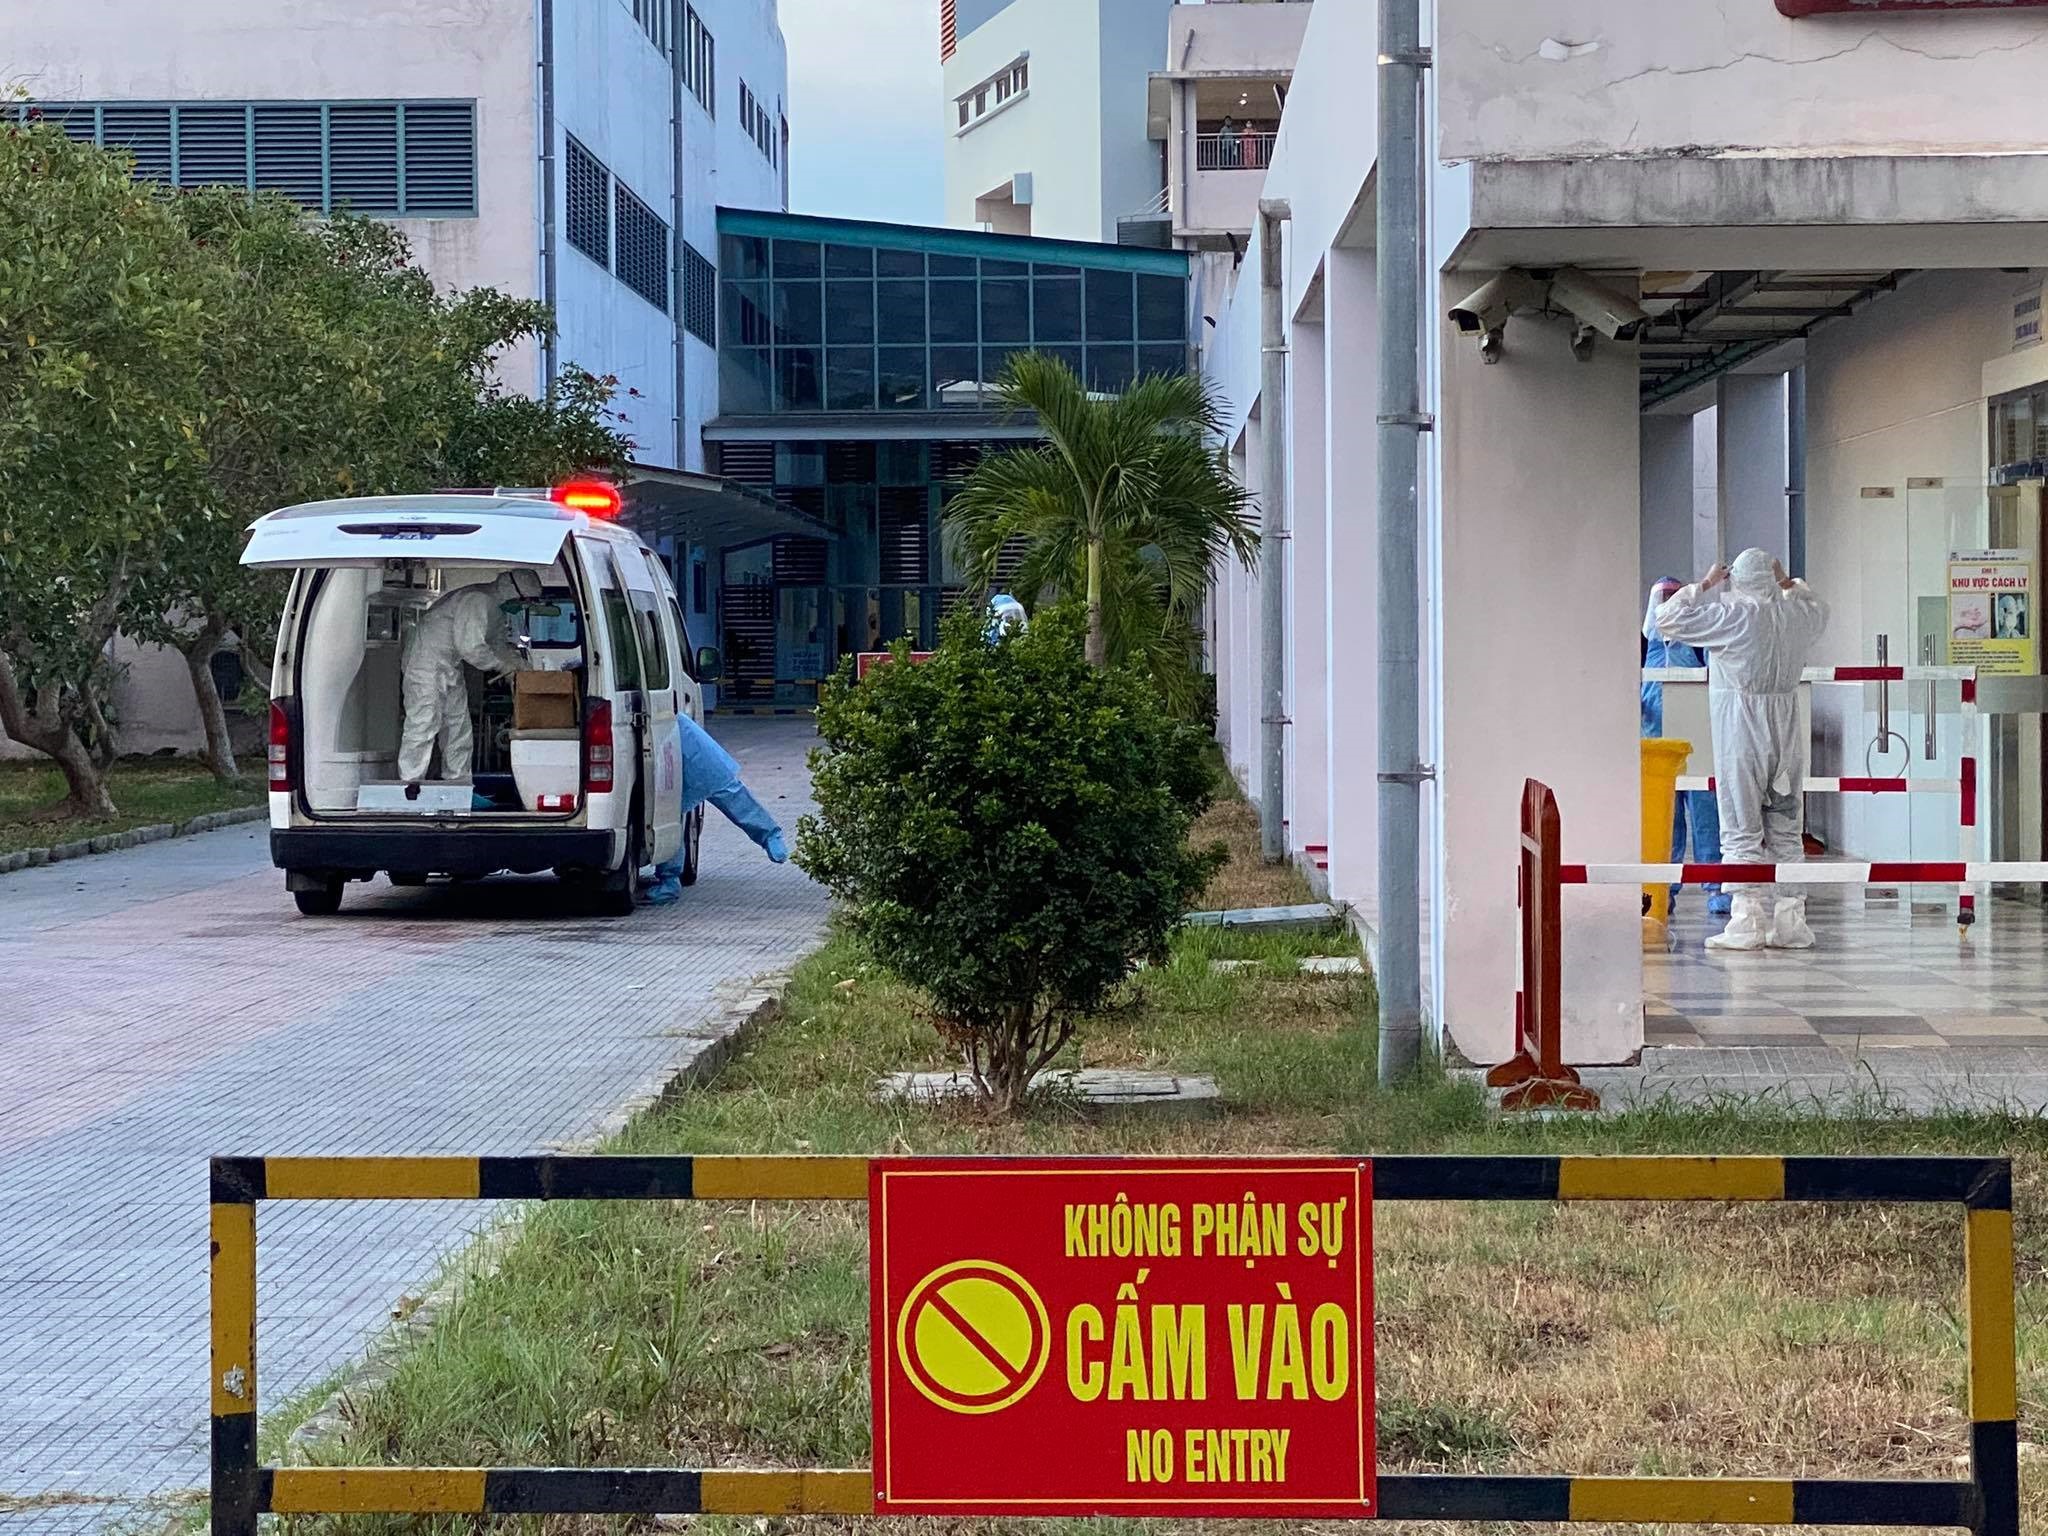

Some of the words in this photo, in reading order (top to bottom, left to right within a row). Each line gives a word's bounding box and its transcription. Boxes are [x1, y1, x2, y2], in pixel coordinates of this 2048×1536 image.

[1952, 578, 1970, 588] KHU
[1972, 577, 1990, 590] VỰC
[1065, 1192, 1182, 1258] KHÔNG
[1193, 1191, 1287, 1269] PHẬN
[1297, 1197, 1347, 1269] SỰ
[1066, 1268, 1207, 1402] CẤM
[1228, 1283, 1350, 1402] VÀO
[1126, 1429, 1174, 1483] NO
[1185, 1429, 1291, 1483] ENTRY
